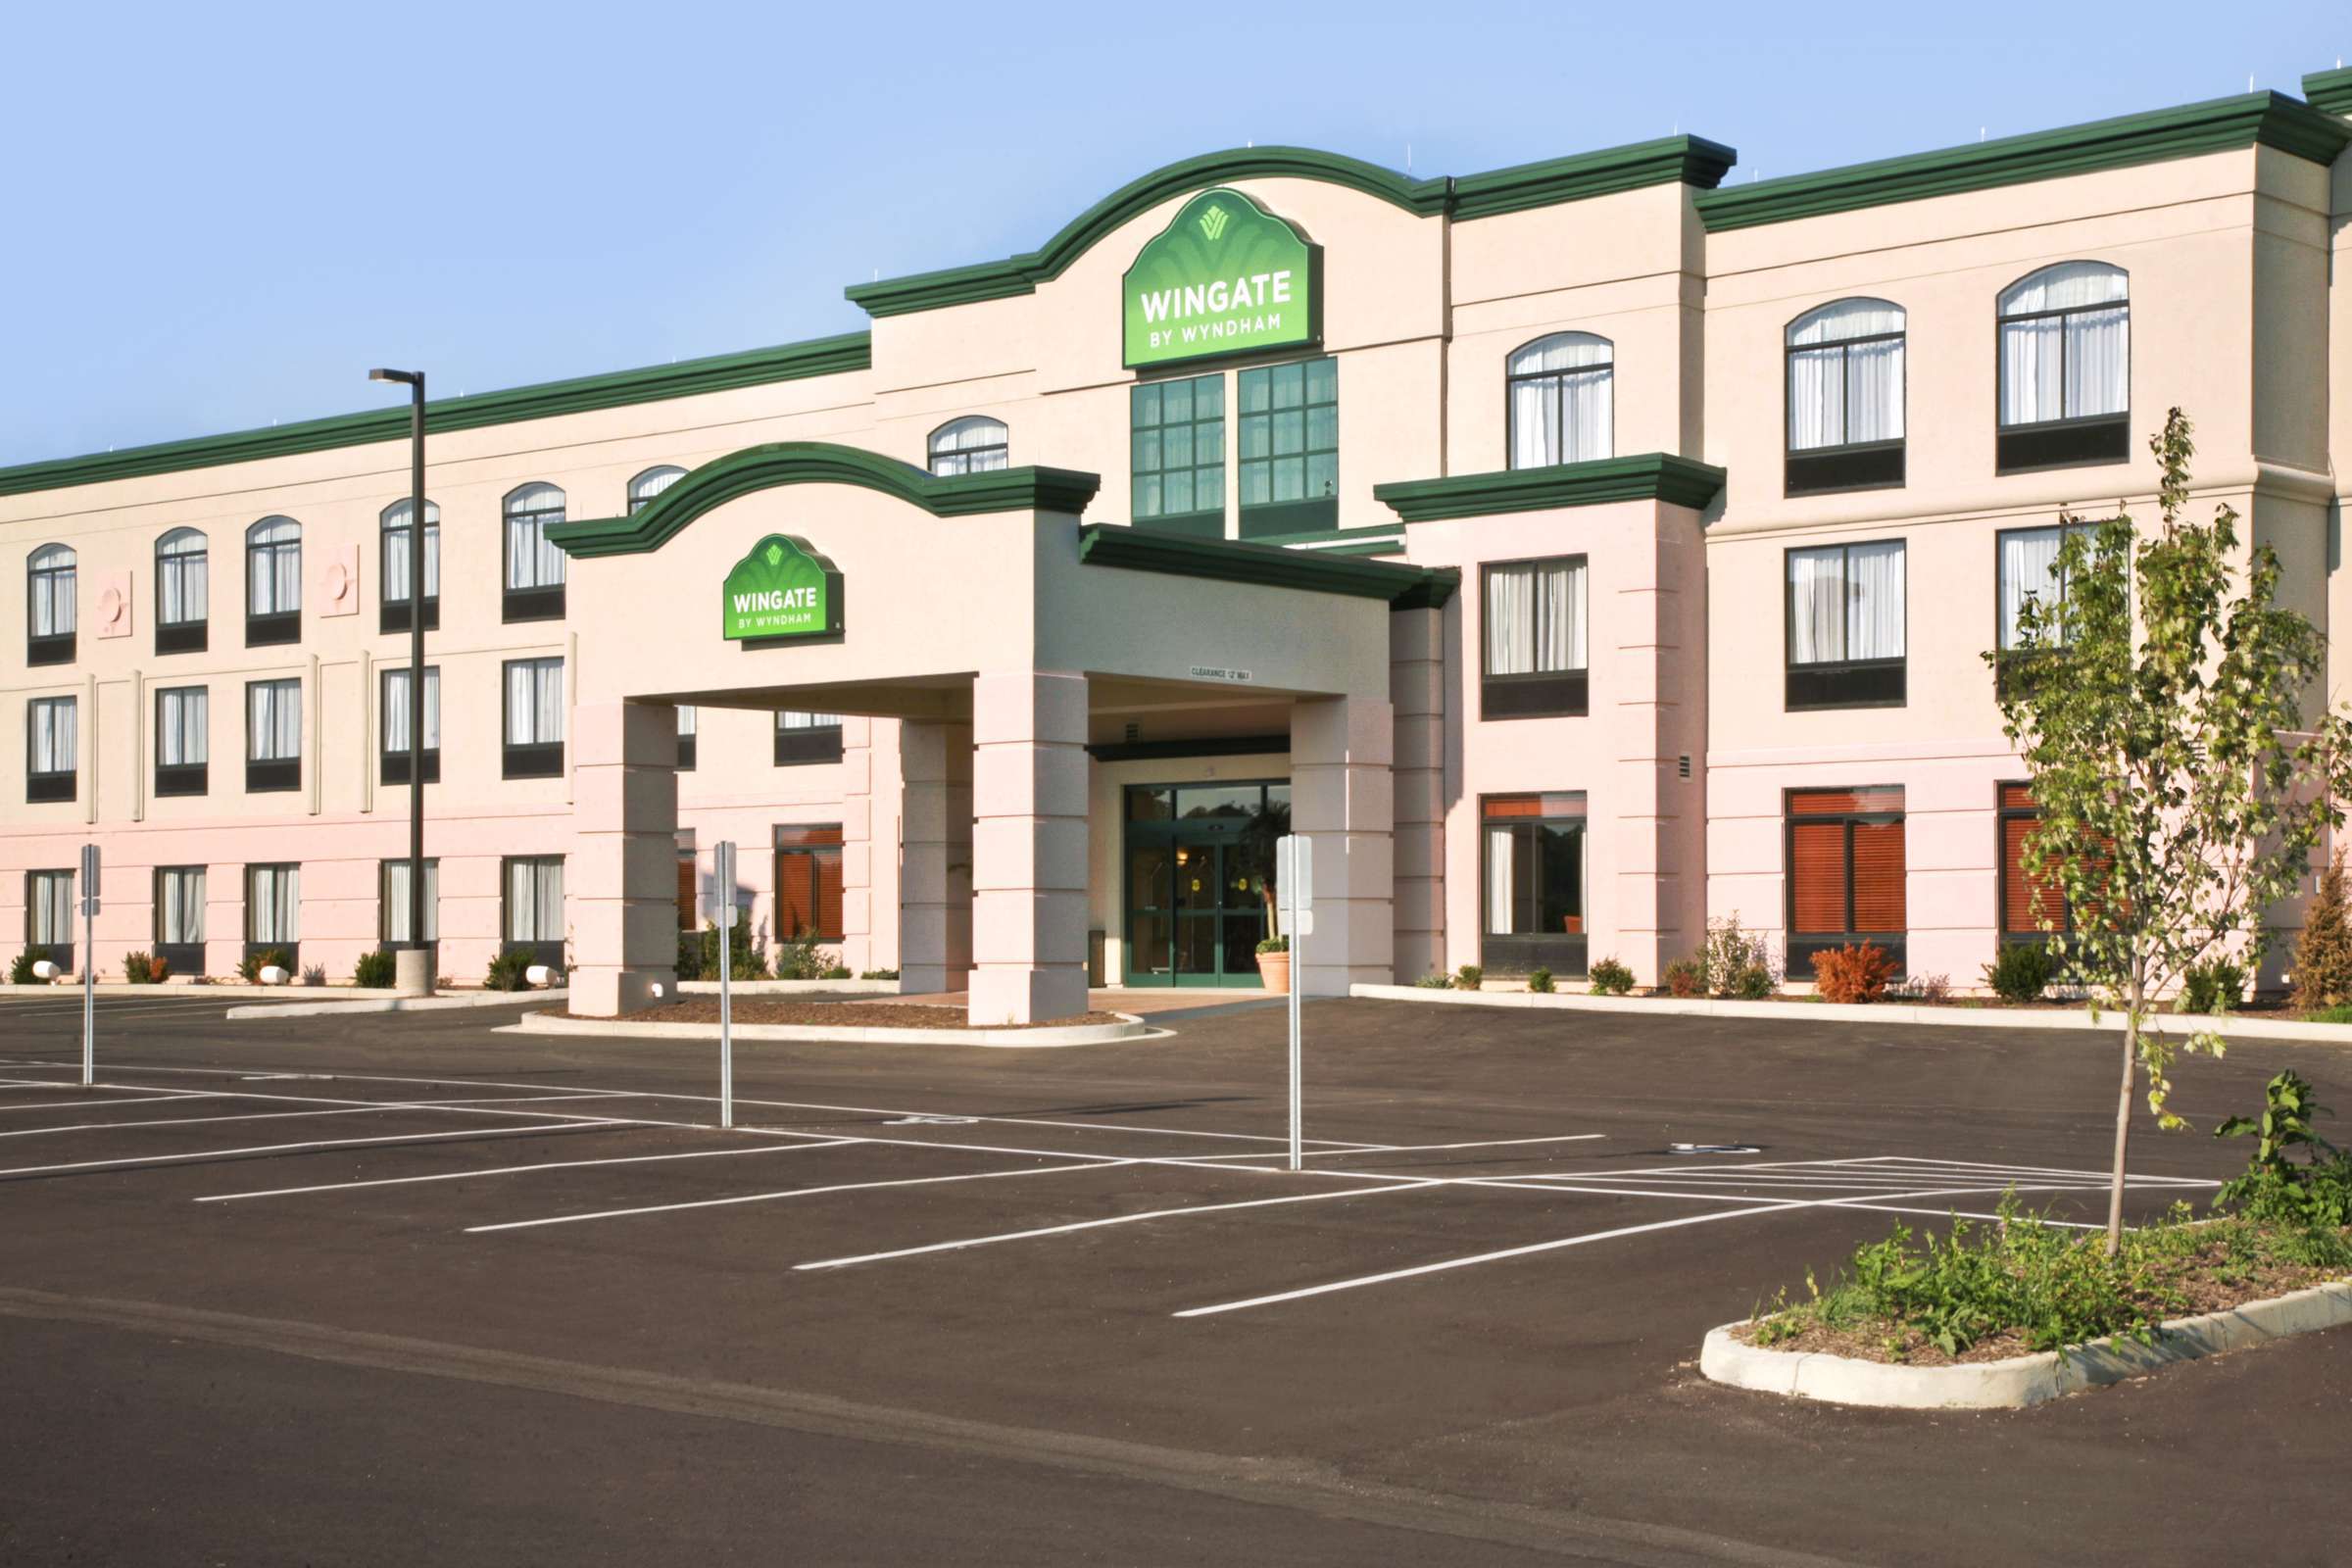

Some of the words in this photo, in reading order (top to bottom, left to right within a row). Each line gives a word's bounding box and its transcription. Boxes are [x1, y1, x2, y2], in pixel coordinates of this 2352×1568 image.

[1141, 270, 1292, 322] WINGATE
[1150, 330, 1173, 348] BY
[1182, 313, 1281, 343] WYNDHAM
[733, 587, 817, 613] WINGATE
[738, 618, 752, 629] BY
[756, 612, 811, 627] WYNDHAM
[1191, 666, 1226, 678] CLEARANCE
